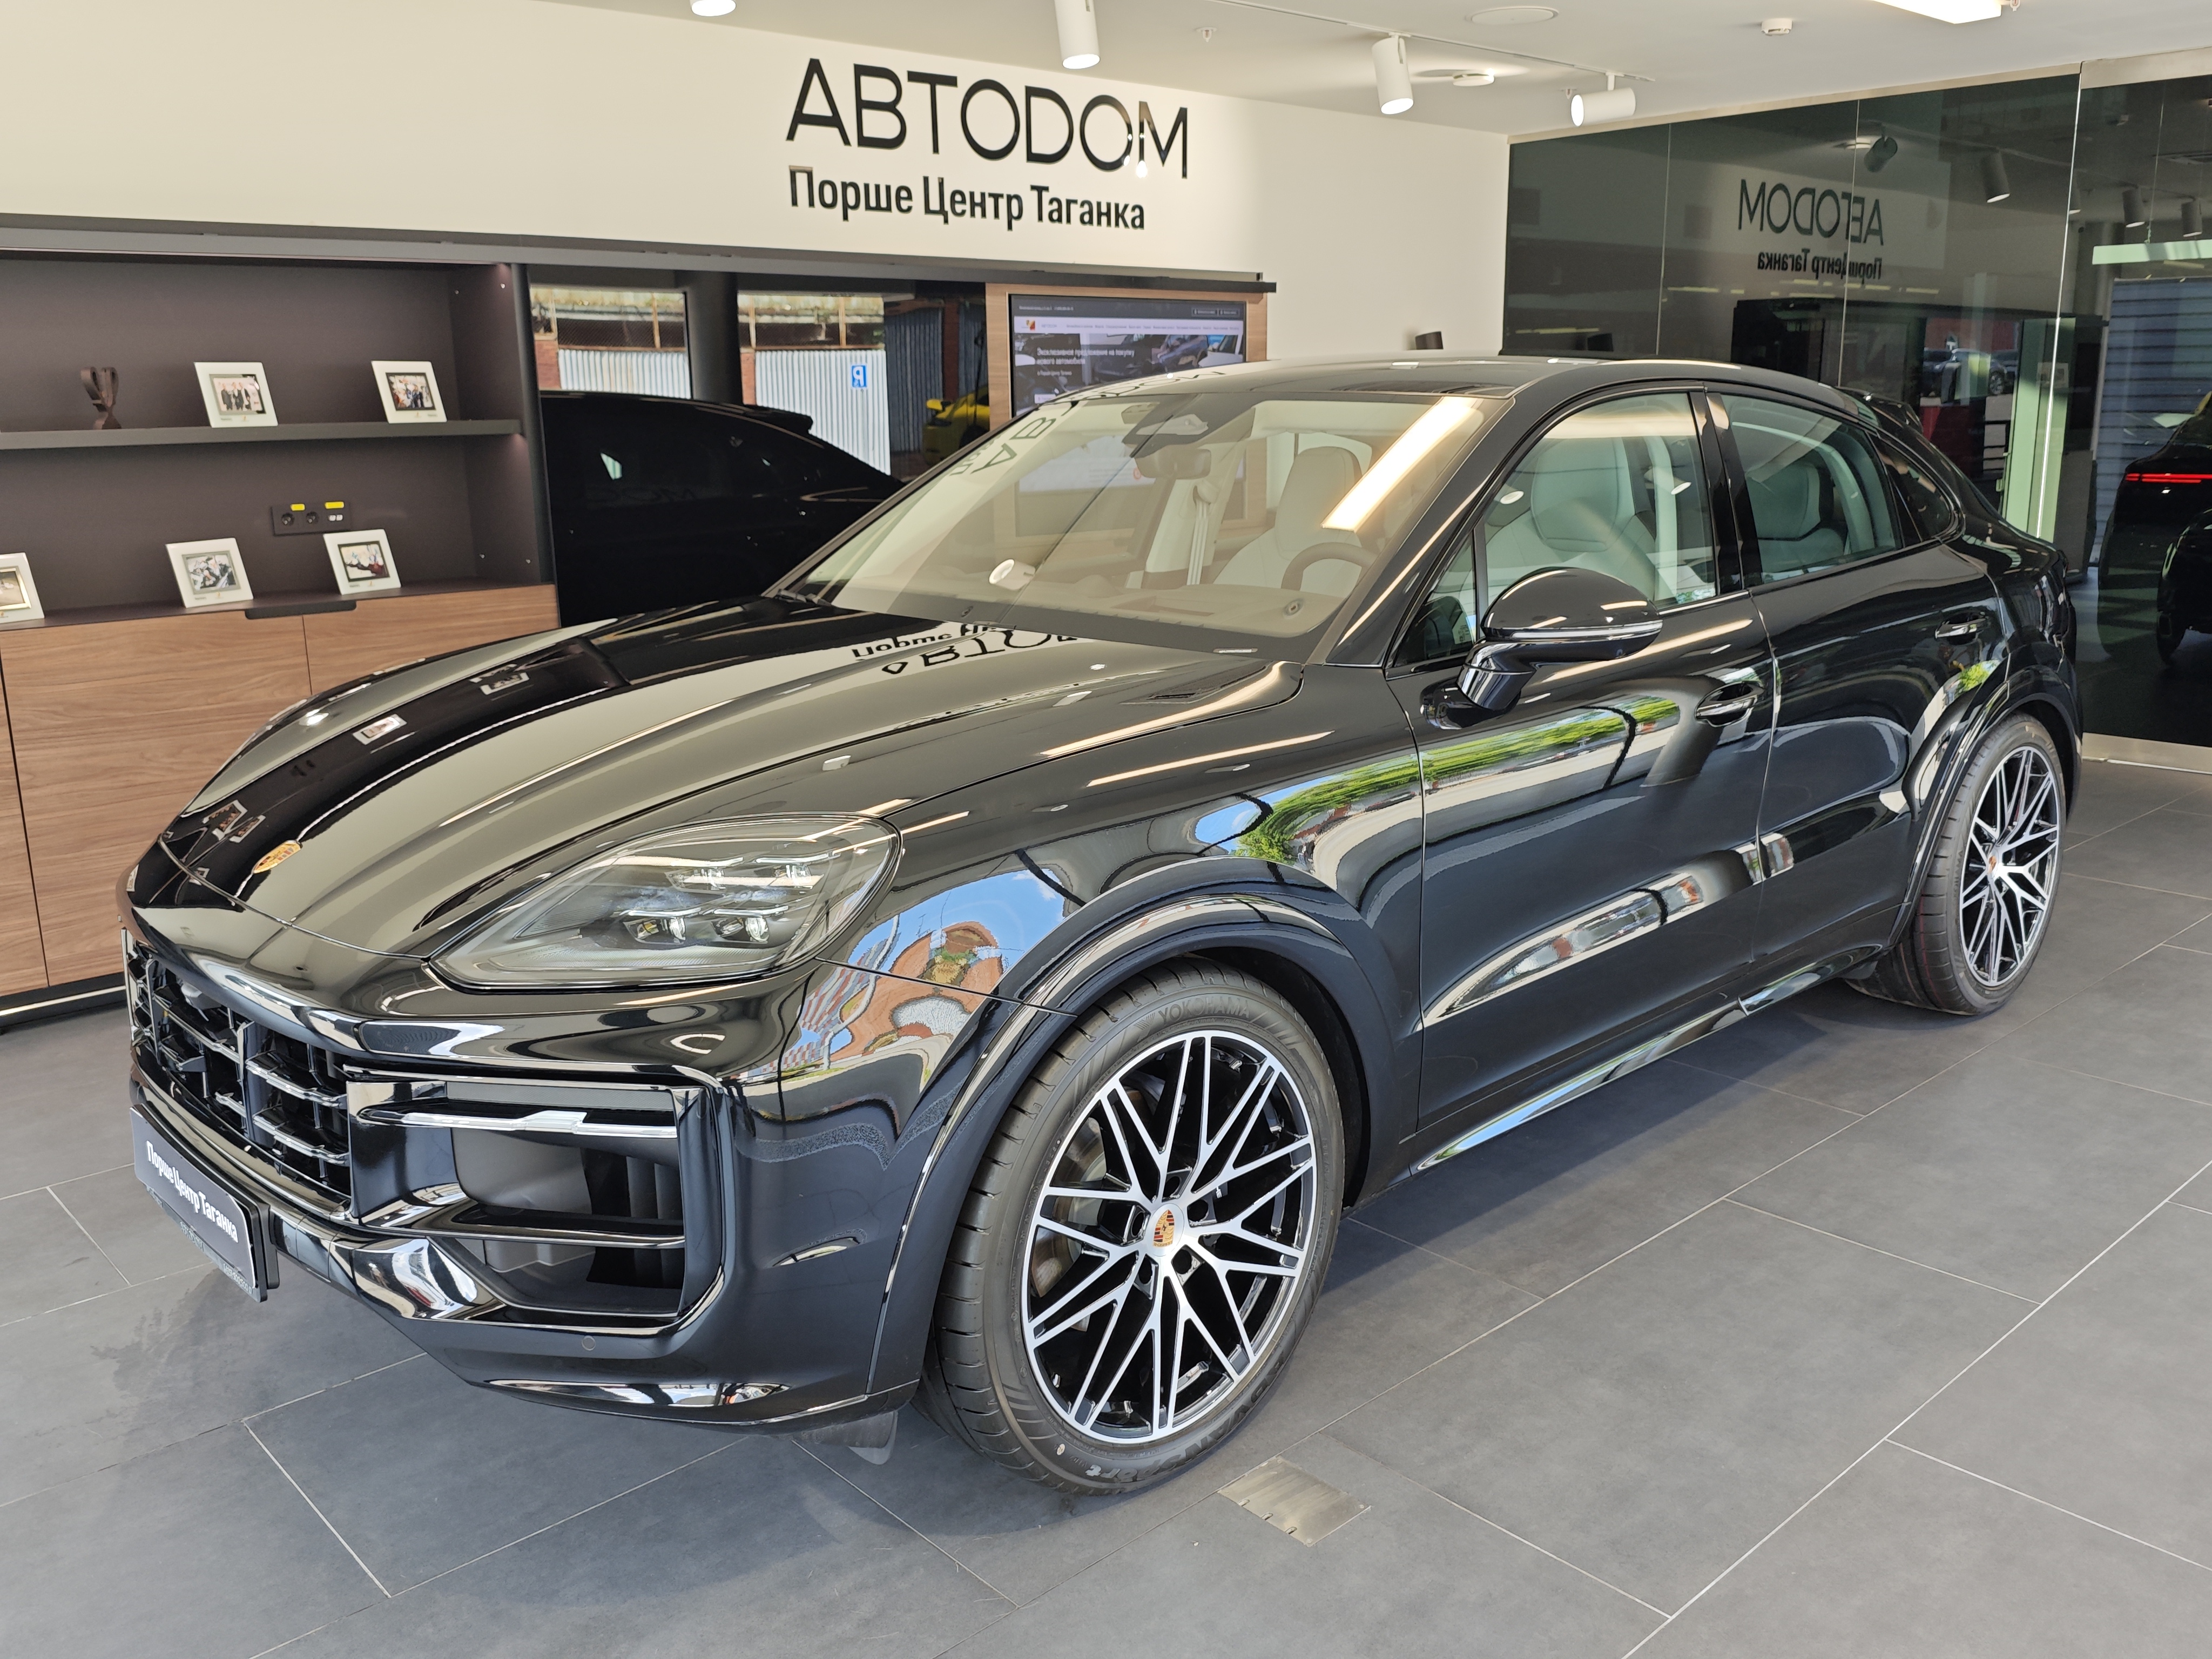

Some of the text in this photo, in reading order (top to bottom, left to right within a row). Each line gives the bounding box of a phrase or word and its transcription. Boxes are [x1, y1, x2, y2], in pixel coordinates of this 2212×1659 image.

[788, 165, 1145, 231] Порше Центр Таганка
[1158, 996, 1250, 1025] YOKOHAMA
[146, 1140, 174, 1184] Порше
[173, 1166, 200, 1213] Центр
[198, 1191, 239, 1243] Таганка
